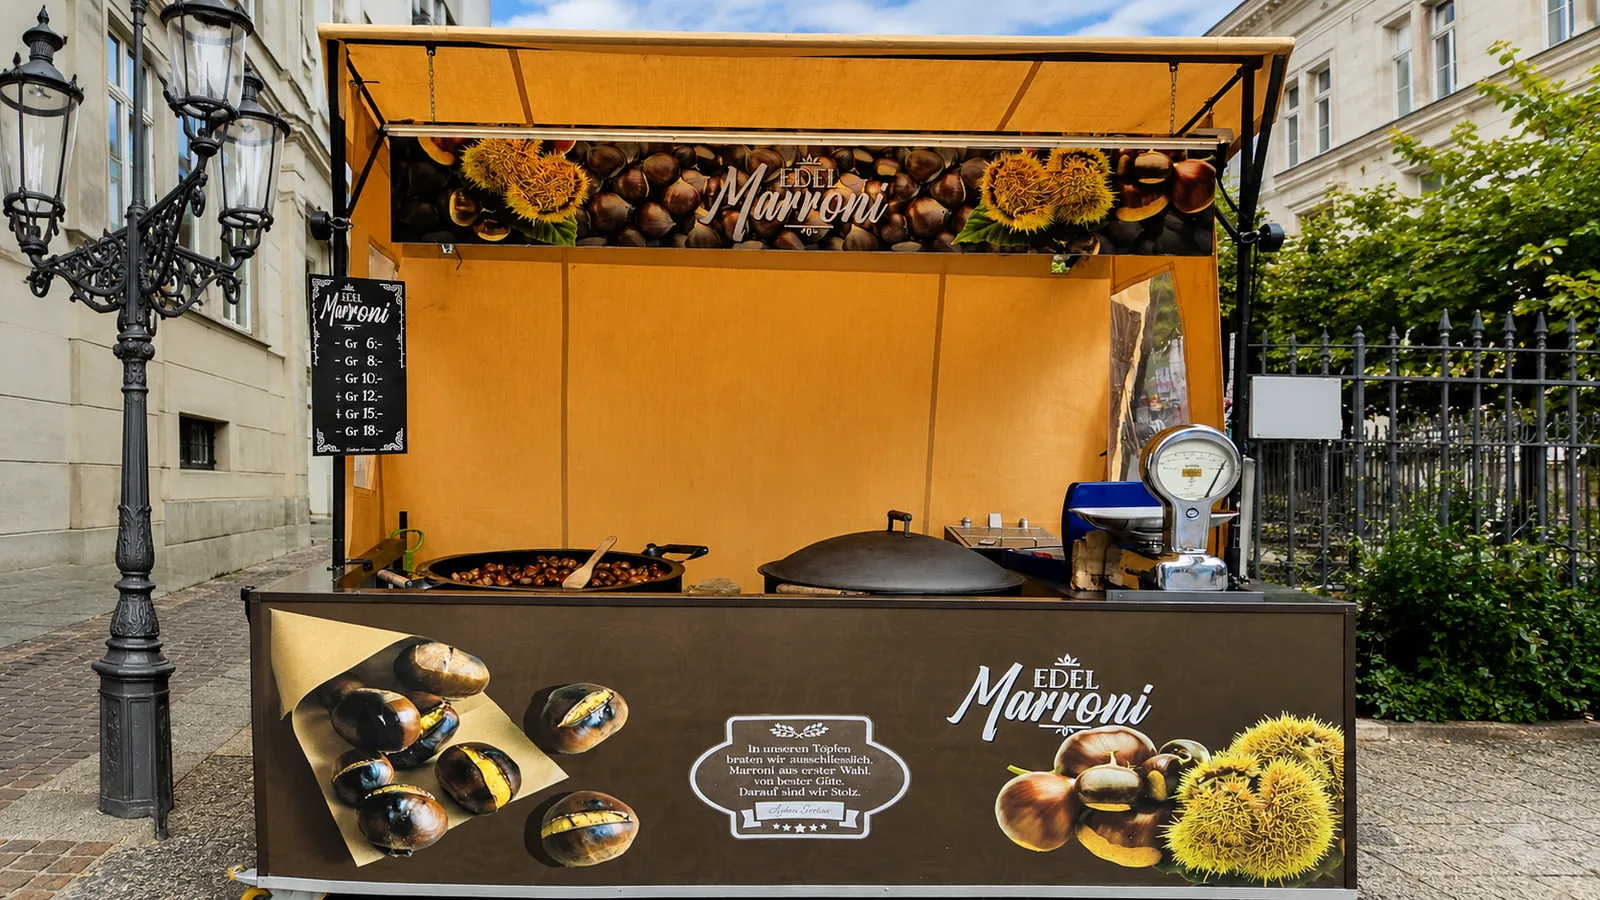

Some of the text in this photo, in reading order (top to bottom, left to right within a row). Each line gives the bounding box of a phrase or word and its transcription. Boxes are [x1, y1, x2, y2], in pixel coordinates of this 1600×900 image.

[779, 167, 838, 188] EDEL
[700, 163, 889, 242] Marroni
[344, 338, 359, 349] Gr
[344, 355, 359, 366] Gr
[344, 373, 359, 384] Gr
[344, 391, 359, 402] Gr
[344, 408, 360, 419] Gr
[344, 426, 359, 436] Gr
[1033, 668, 1100, 690] EDEL
[946, 661, 1154, 742] Marroni
[748, 744, 761, 754] In
[726, 754, 763, 764] braten
[767, 754, 787, 764] wir
[729, 765, 775, 775] Marroni
[778, 766, 799, 775] aus
[801, 766, 837, 775] erster
[753, 778, 774, 786] von
[739, 786, 861, 797] Darauf sind wir Stolz.
